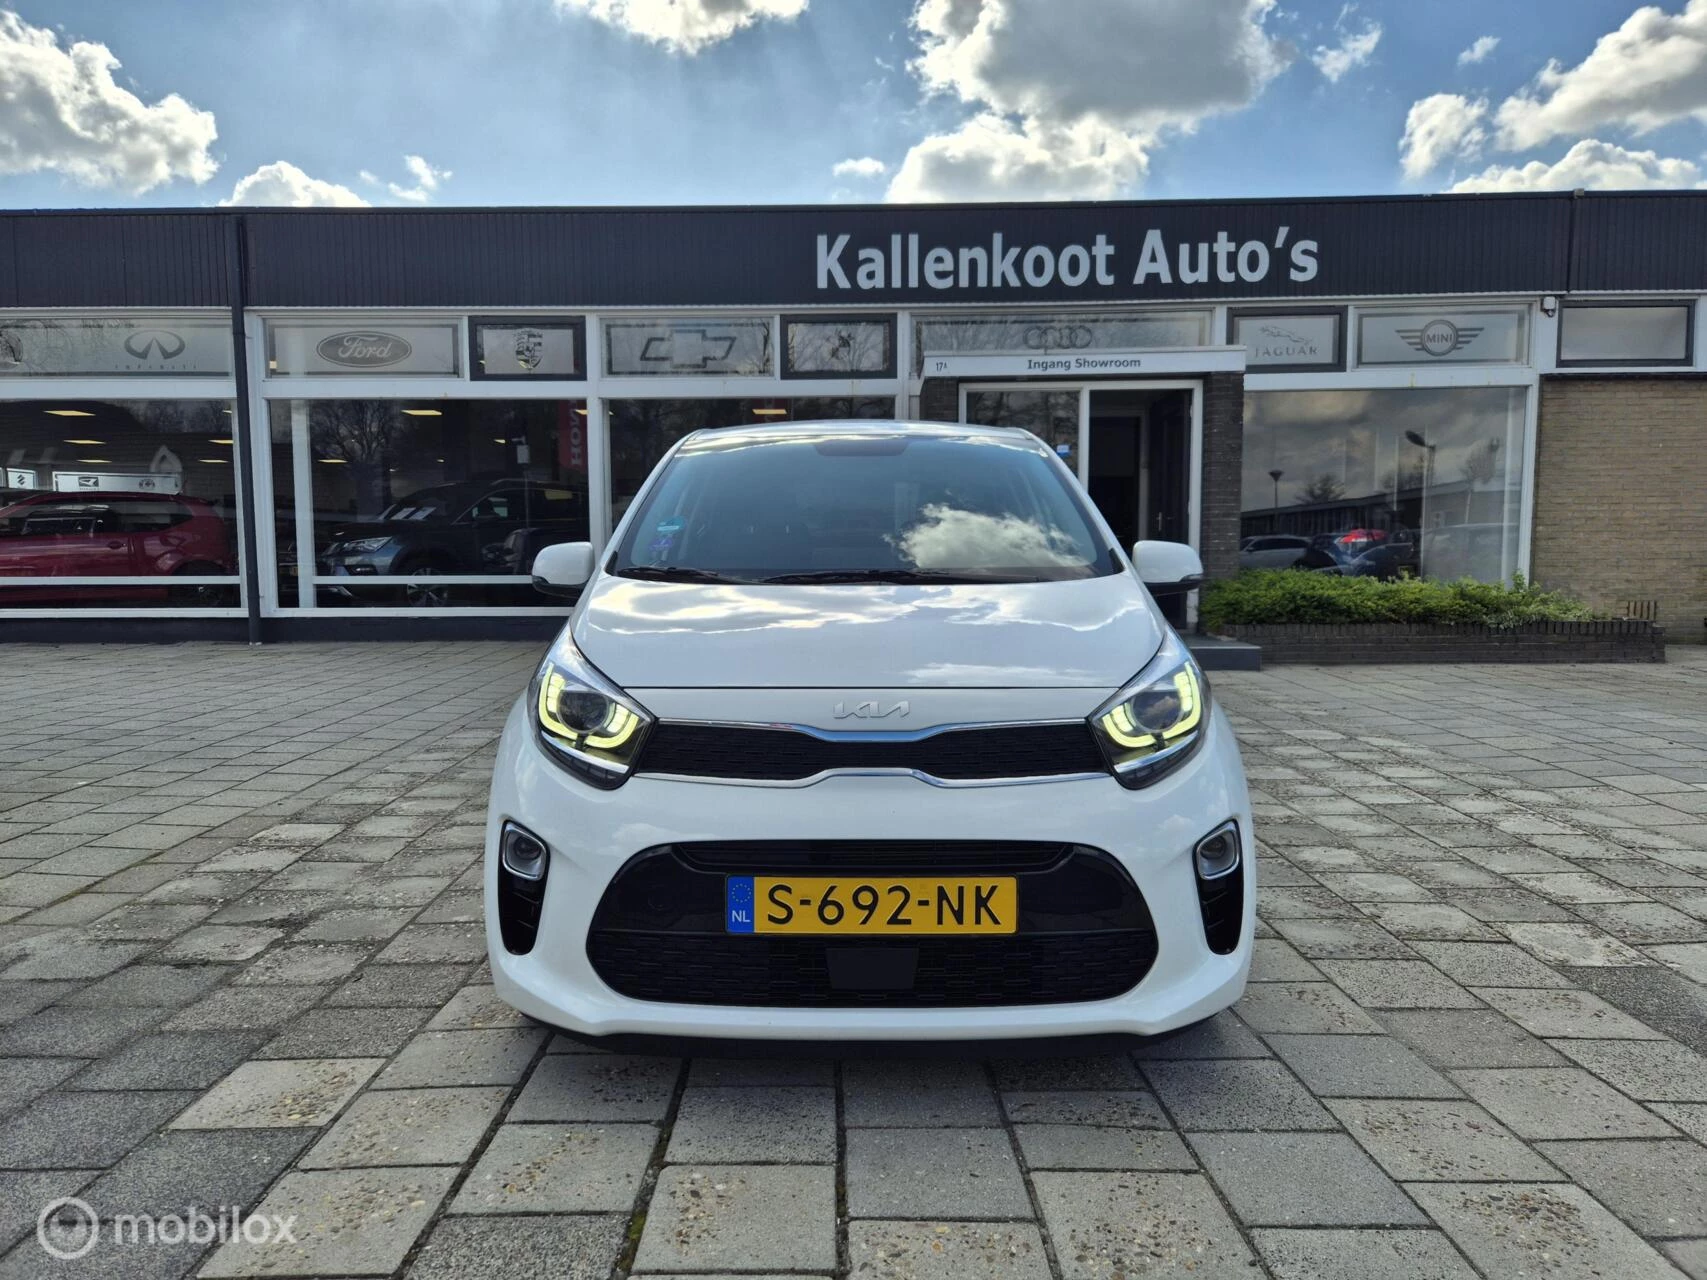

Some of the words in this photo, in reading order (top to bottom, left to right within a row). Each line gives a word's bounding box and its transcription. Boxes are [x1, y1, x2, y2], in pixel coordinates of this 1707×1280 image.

[816, 232, 1115, 289] Kallenkoot
[1133, 226, 1319, 285] Auto's
[338, 335, 393, 358] Ford
[1426, 333, 1453, 344] MINI
[1254, 345, 1318, 358] JAGUAR
[1027, 358, 1072, 371] Ingang
[1075, 357, 1141, 369] Showroom
[833, 700, 911, 719] KIA
[767, 885, 1002, 925] S-692-NK
[731, 909, 751, 923] NL
